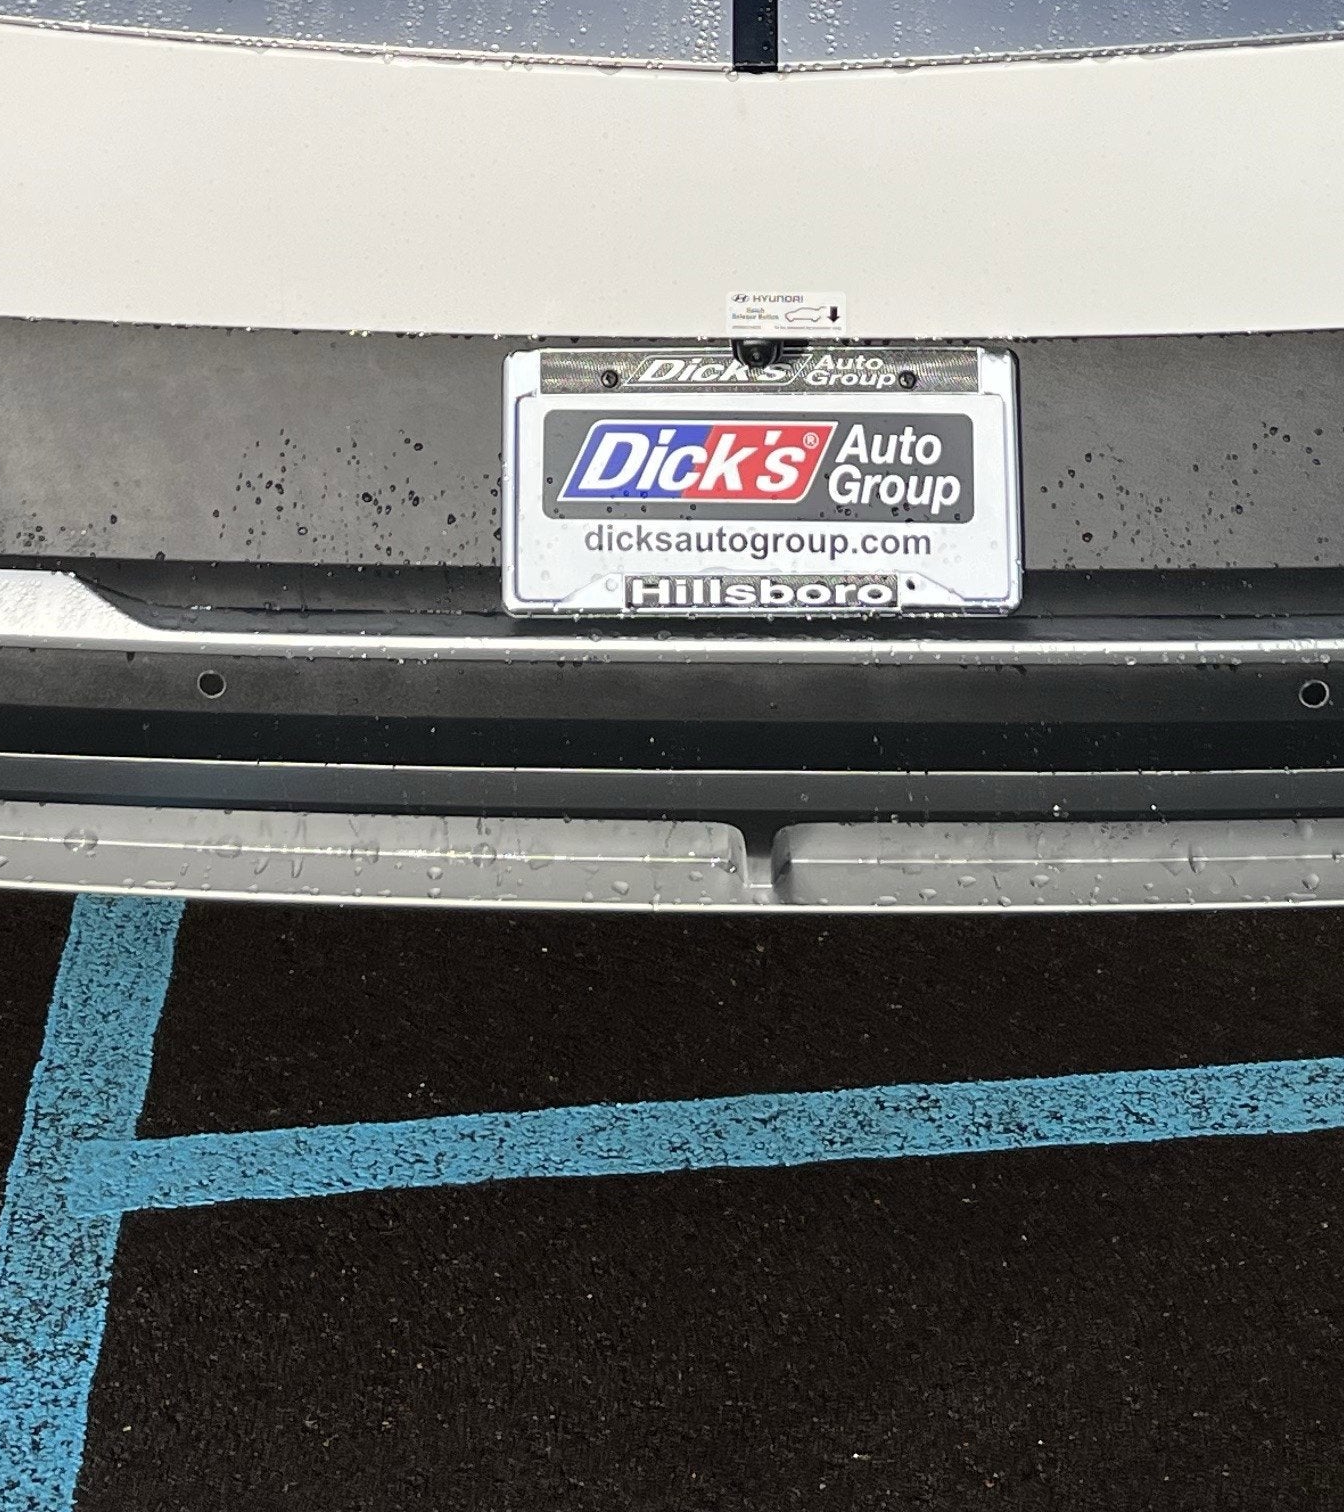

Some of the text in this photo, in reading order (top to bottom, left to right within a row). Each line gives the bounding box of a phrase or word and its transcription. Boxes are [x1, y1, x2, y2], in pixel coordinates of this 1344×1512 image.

[752, 294, 804, 303] HYUNDAI
[638, 354, 884, 383] Dicks Auto
[806, 370, 897, 389] Group
[577, 424, 943, 493] Dick's Auto
[828, 464, 962, 515] Group
[584, 524, 932, 560] dicksautogroup.com
[631, 578, 894, 607] Hillsboro
